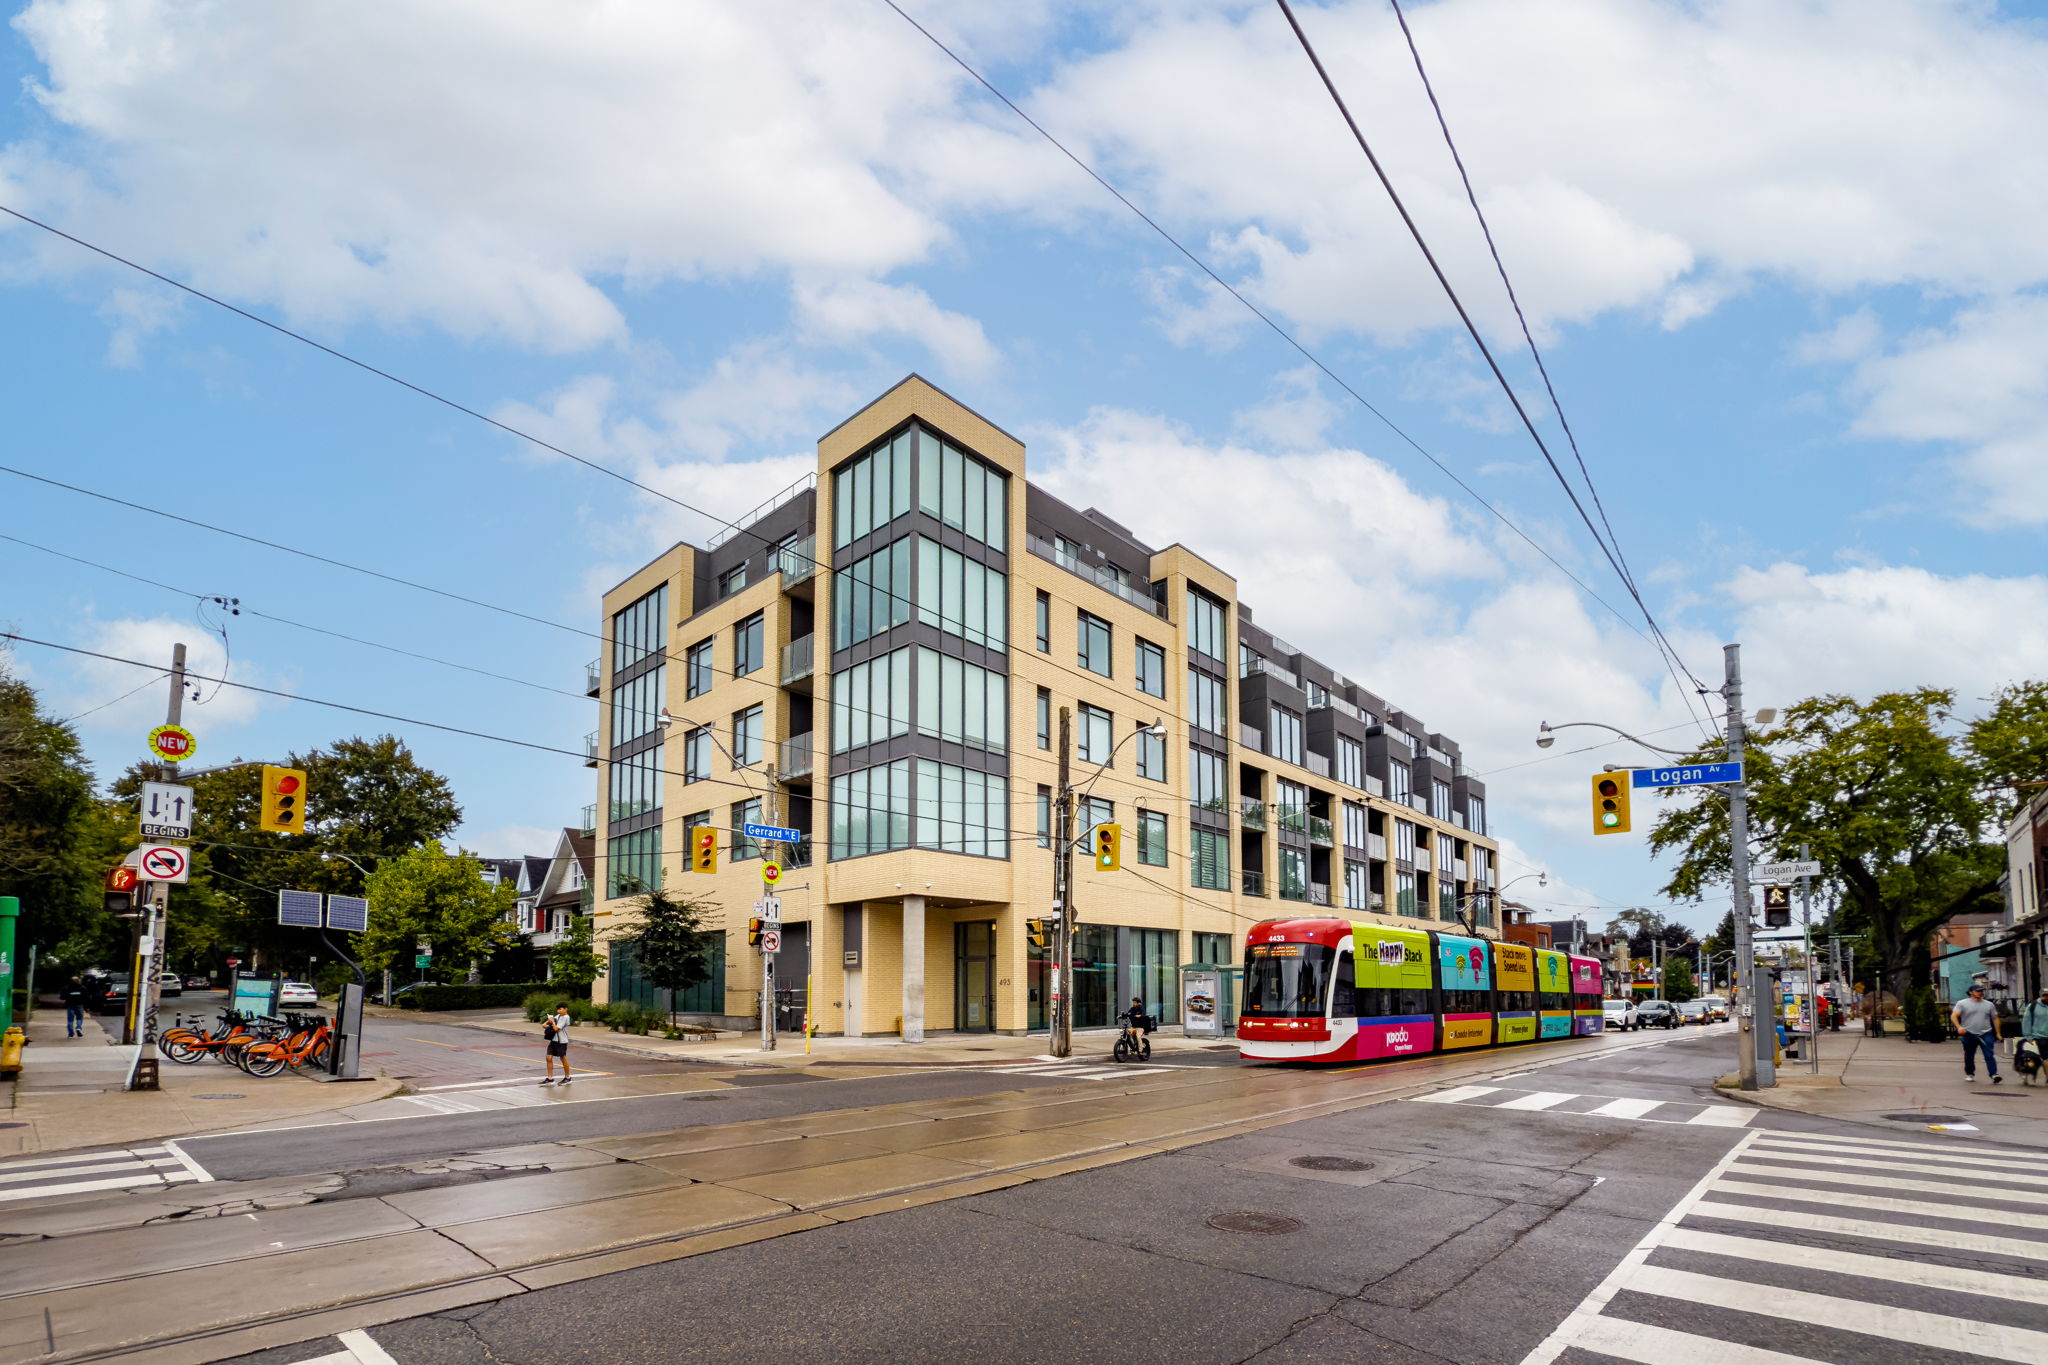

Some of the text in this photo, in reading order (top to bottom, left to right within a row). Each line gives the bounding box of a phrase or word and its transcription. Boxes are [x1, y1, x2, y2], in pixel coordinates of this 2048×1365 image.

[157, 735, 187, 750] NEW
[1651, 765, 1720, 784] Logan Av
[145, 824, 185, 837] BEGINS
[748, 825, 782, 838] Gerrard
[791, 831, 796, 840] E
[765, 868, 778, 876] NEW
[1763, 864, 1812, 876] Logan Ave
[765, 922, 780, 930] BEGINS
[1363, 943, 1378, 959] The
[1405, 947, 1423, 962] Stack
[1502, 947, 1515, 960] Stack
[1504, 960, 1517, 973] Spend
